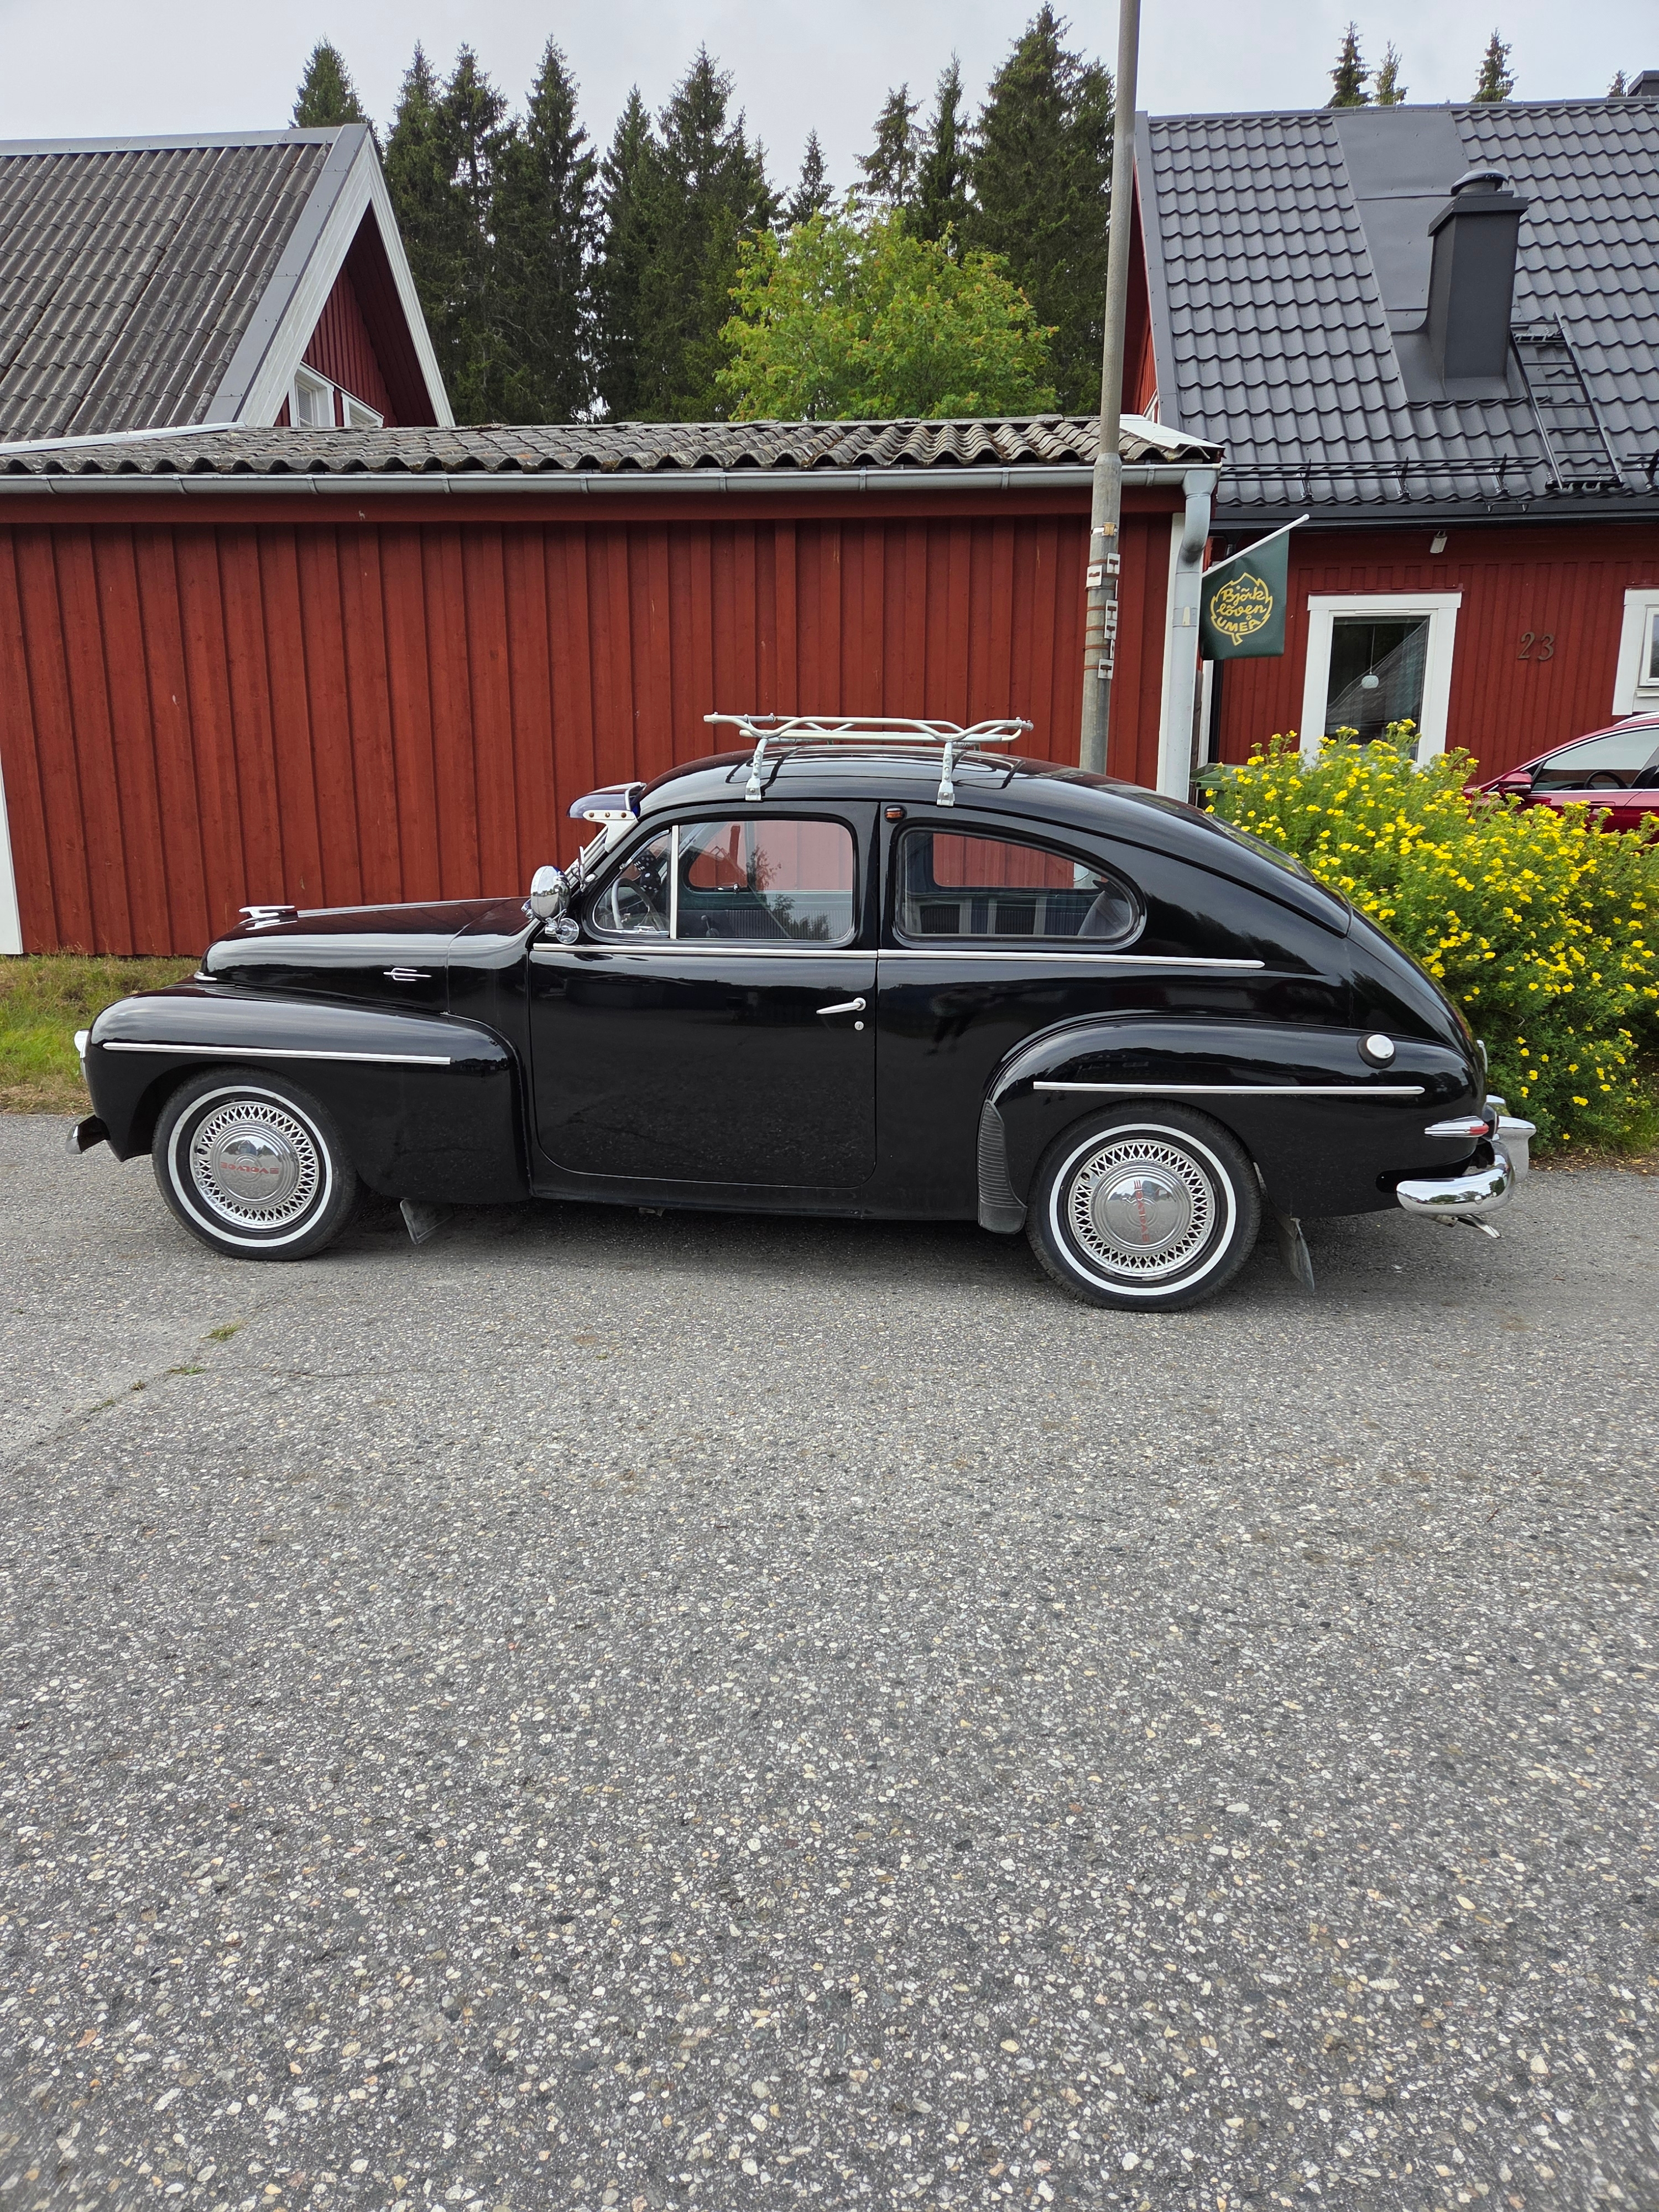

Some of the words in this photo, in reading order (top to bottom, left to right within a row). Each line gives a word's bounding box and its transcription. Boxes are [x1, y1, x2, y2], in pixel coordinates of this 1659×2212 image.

[1220, 585, 1266, 605] Björk
[1217, 602, 1267, 617] löven
[1217, 614, 1261, 632] UMEÅ
[1517, 631, 1554, 661] 23
[227, 1164, 269, 1175] VOLVO
